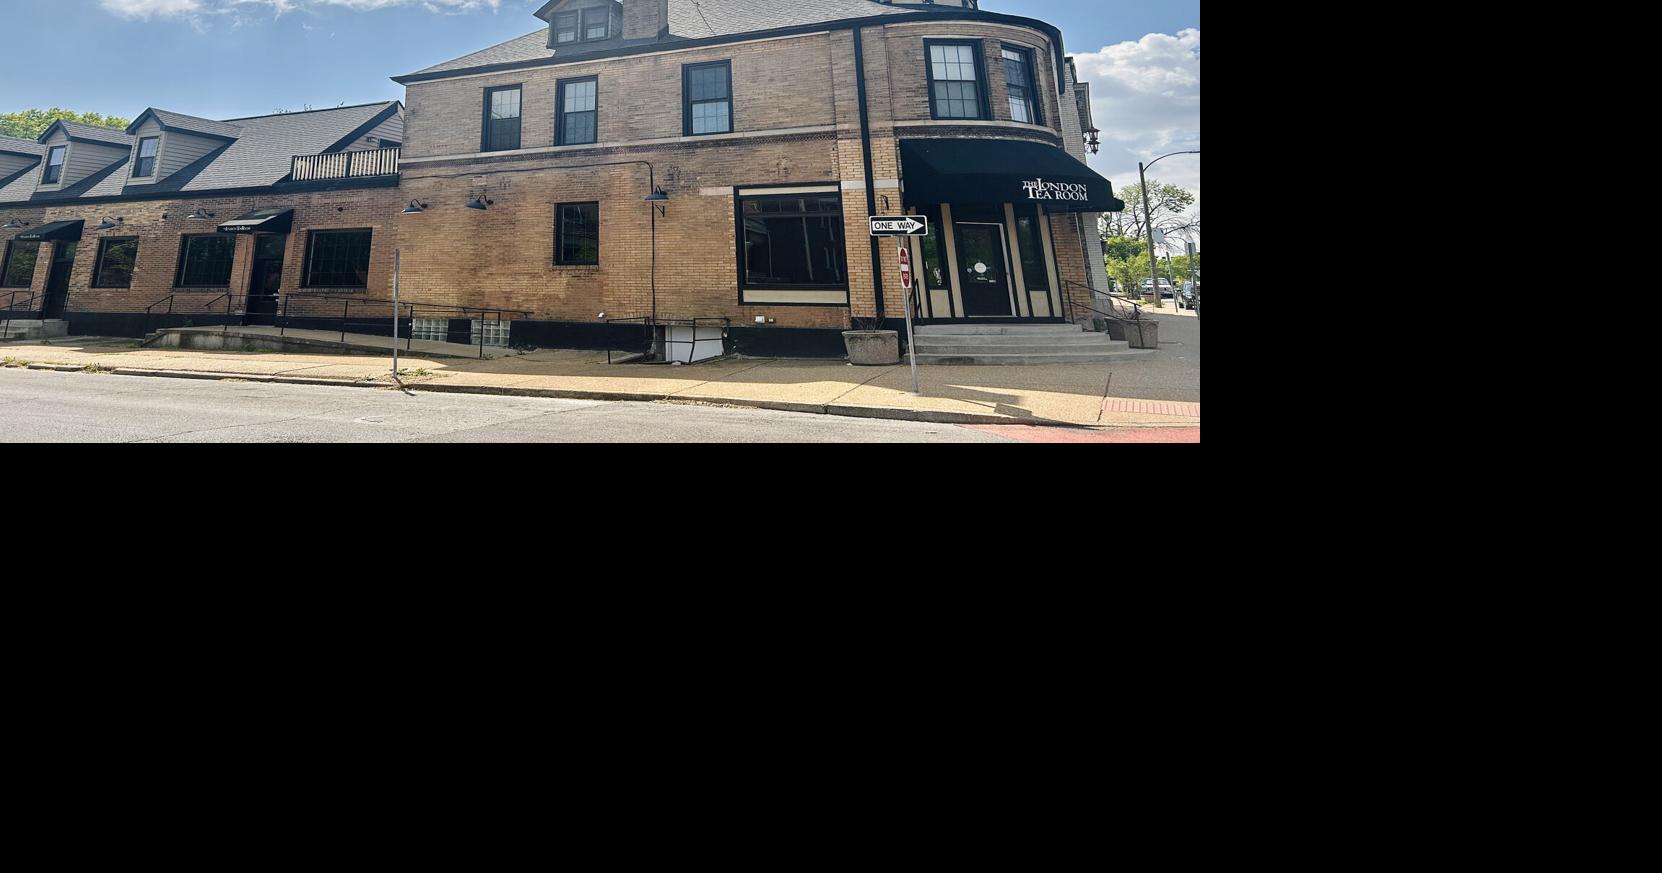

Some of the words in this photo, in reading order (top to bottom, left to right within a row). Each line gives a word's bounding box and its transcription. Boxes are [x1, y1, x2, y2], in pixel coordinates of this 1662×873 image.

[1036, 177, 1087, 192] LONDON
[1022, 186, 1053, 200] TEA
[1055, 190, 1089, 201] ROOM
[874, 221, 893, 230] ONE
[896, 221, 916, 230] WAY
